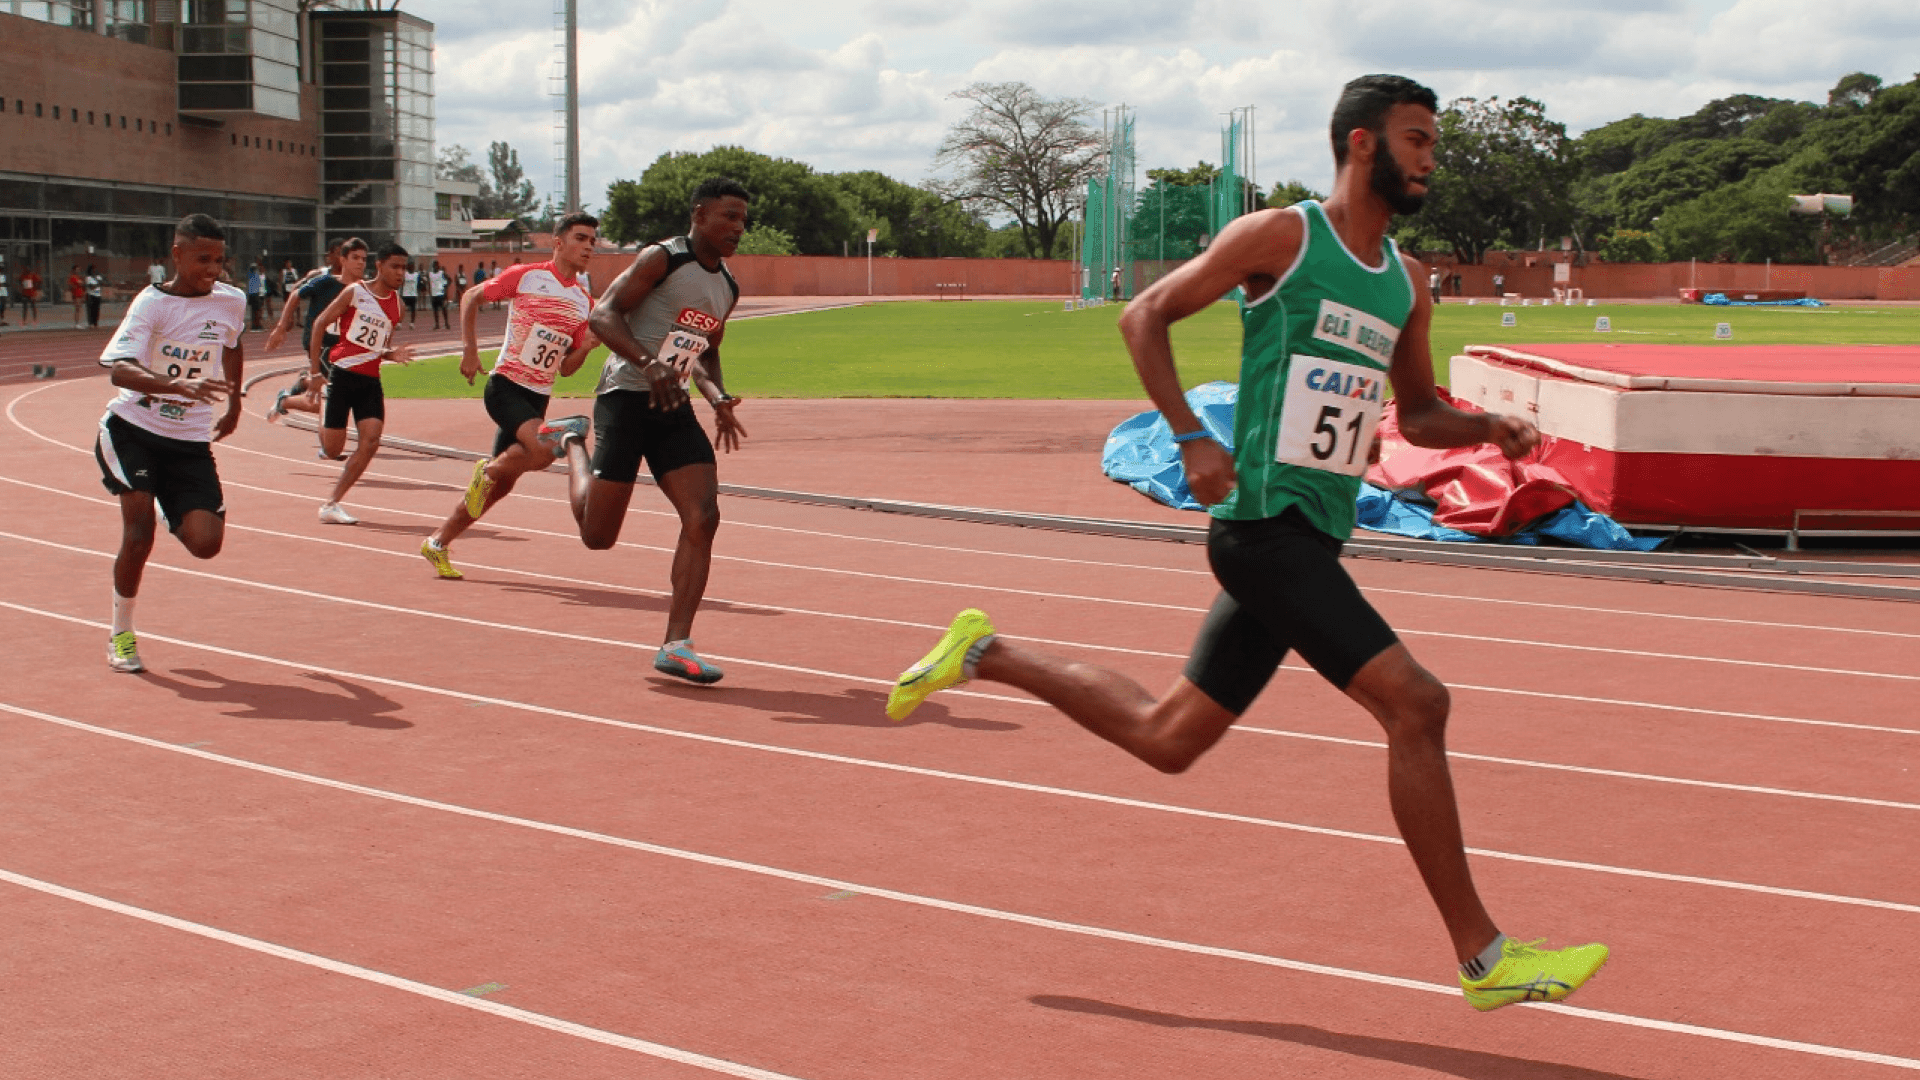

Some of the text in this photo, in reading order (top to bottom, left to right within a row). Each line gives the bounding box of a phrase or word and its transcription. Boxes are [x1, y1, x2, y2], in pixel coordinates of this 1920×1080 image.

[680, 310, 719, 332] SESI
[355, 326, 379, 347] 28
[537, 329, 570, 347] CAIXA
[161, 345, 211, 362] CAIXA
[532, 344, 559, 369] 36
[1306, 368, 1380, 403] CAIXA
[1310, 405, 1365, 465] 51
